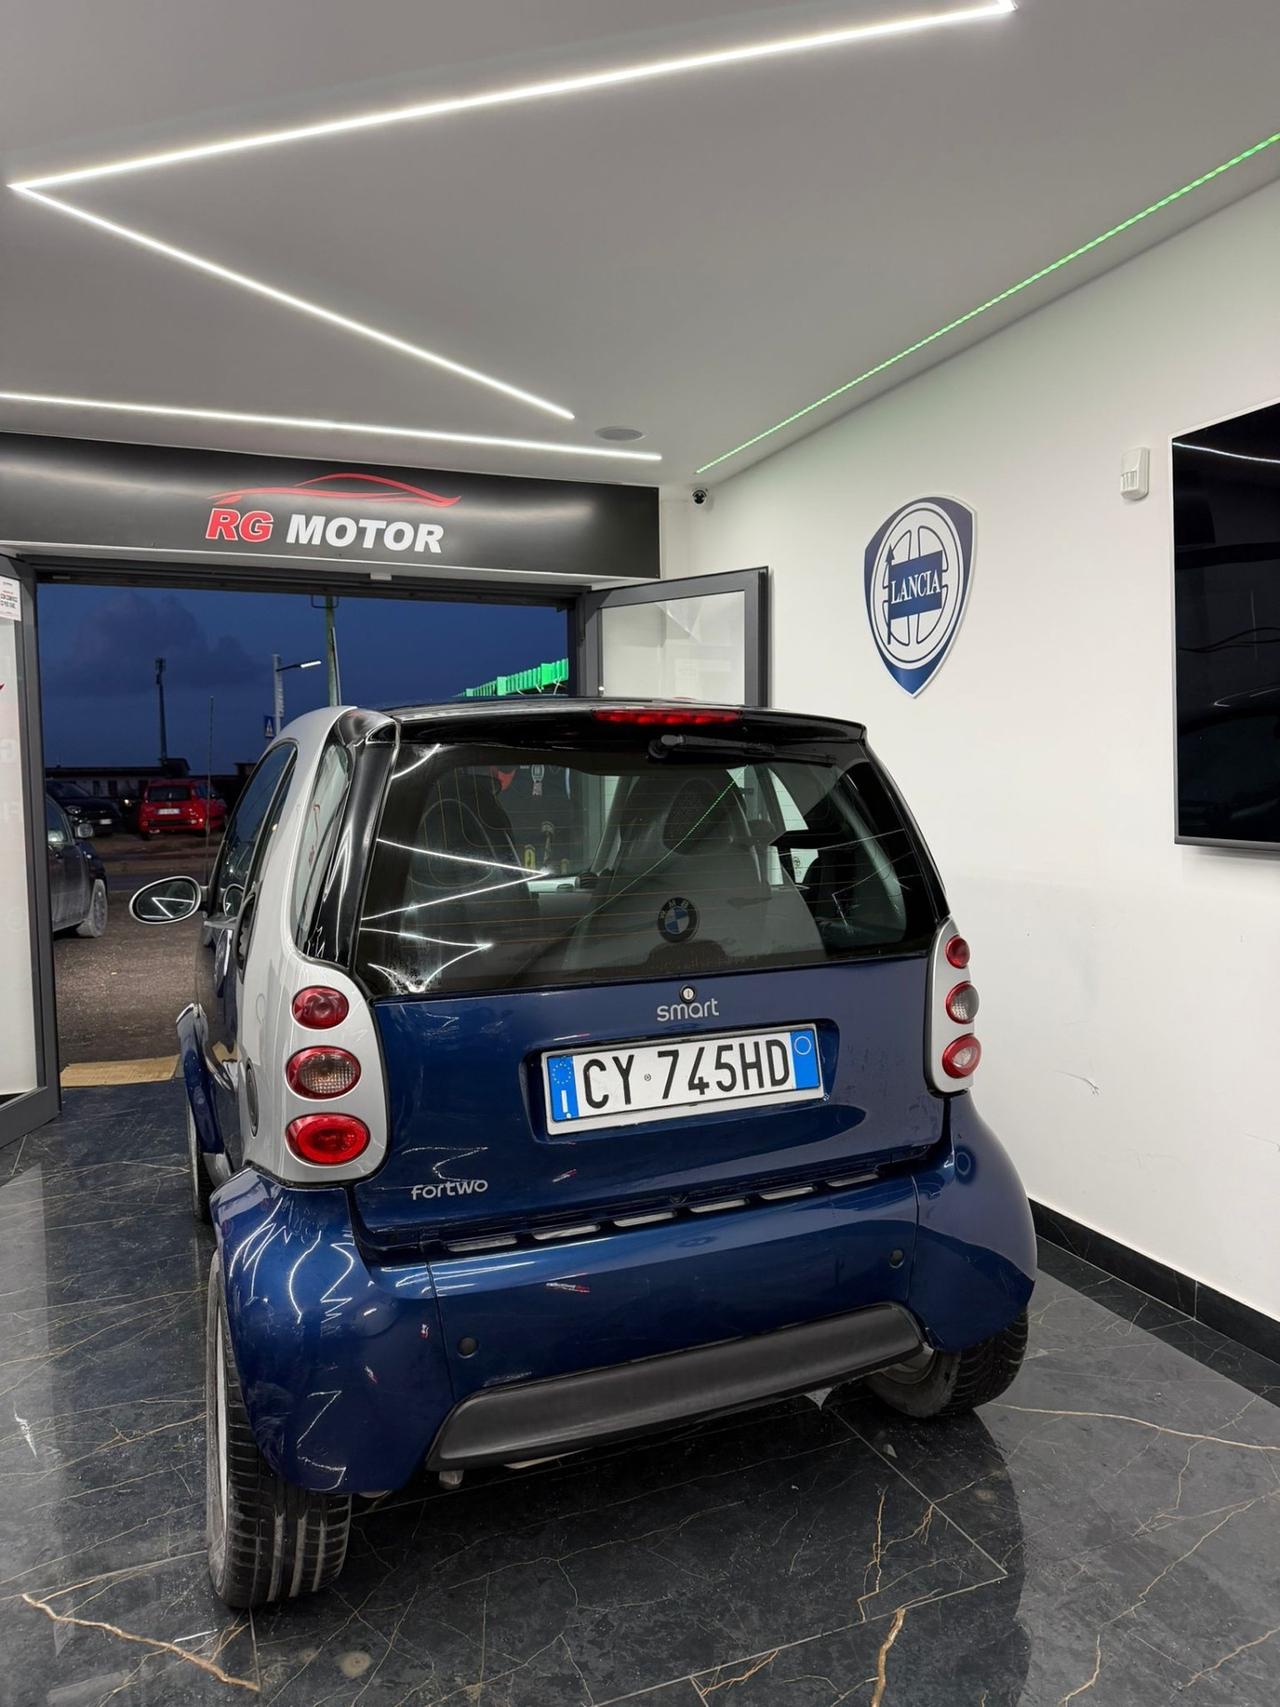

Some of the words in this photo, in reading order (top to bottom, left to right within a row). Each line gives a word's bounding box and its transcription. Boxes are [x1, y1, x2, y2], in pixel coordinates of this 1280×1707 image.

[205, 507, 274, 543] RG
[286, 514, 444, 553] MOTOR
[890, 569, 941, 605] LANCIA
[656, 998, 720, 1022] smart
[583, 1054, 635, 1109] CY
[657, 1039, 790, 1100] 745HD
